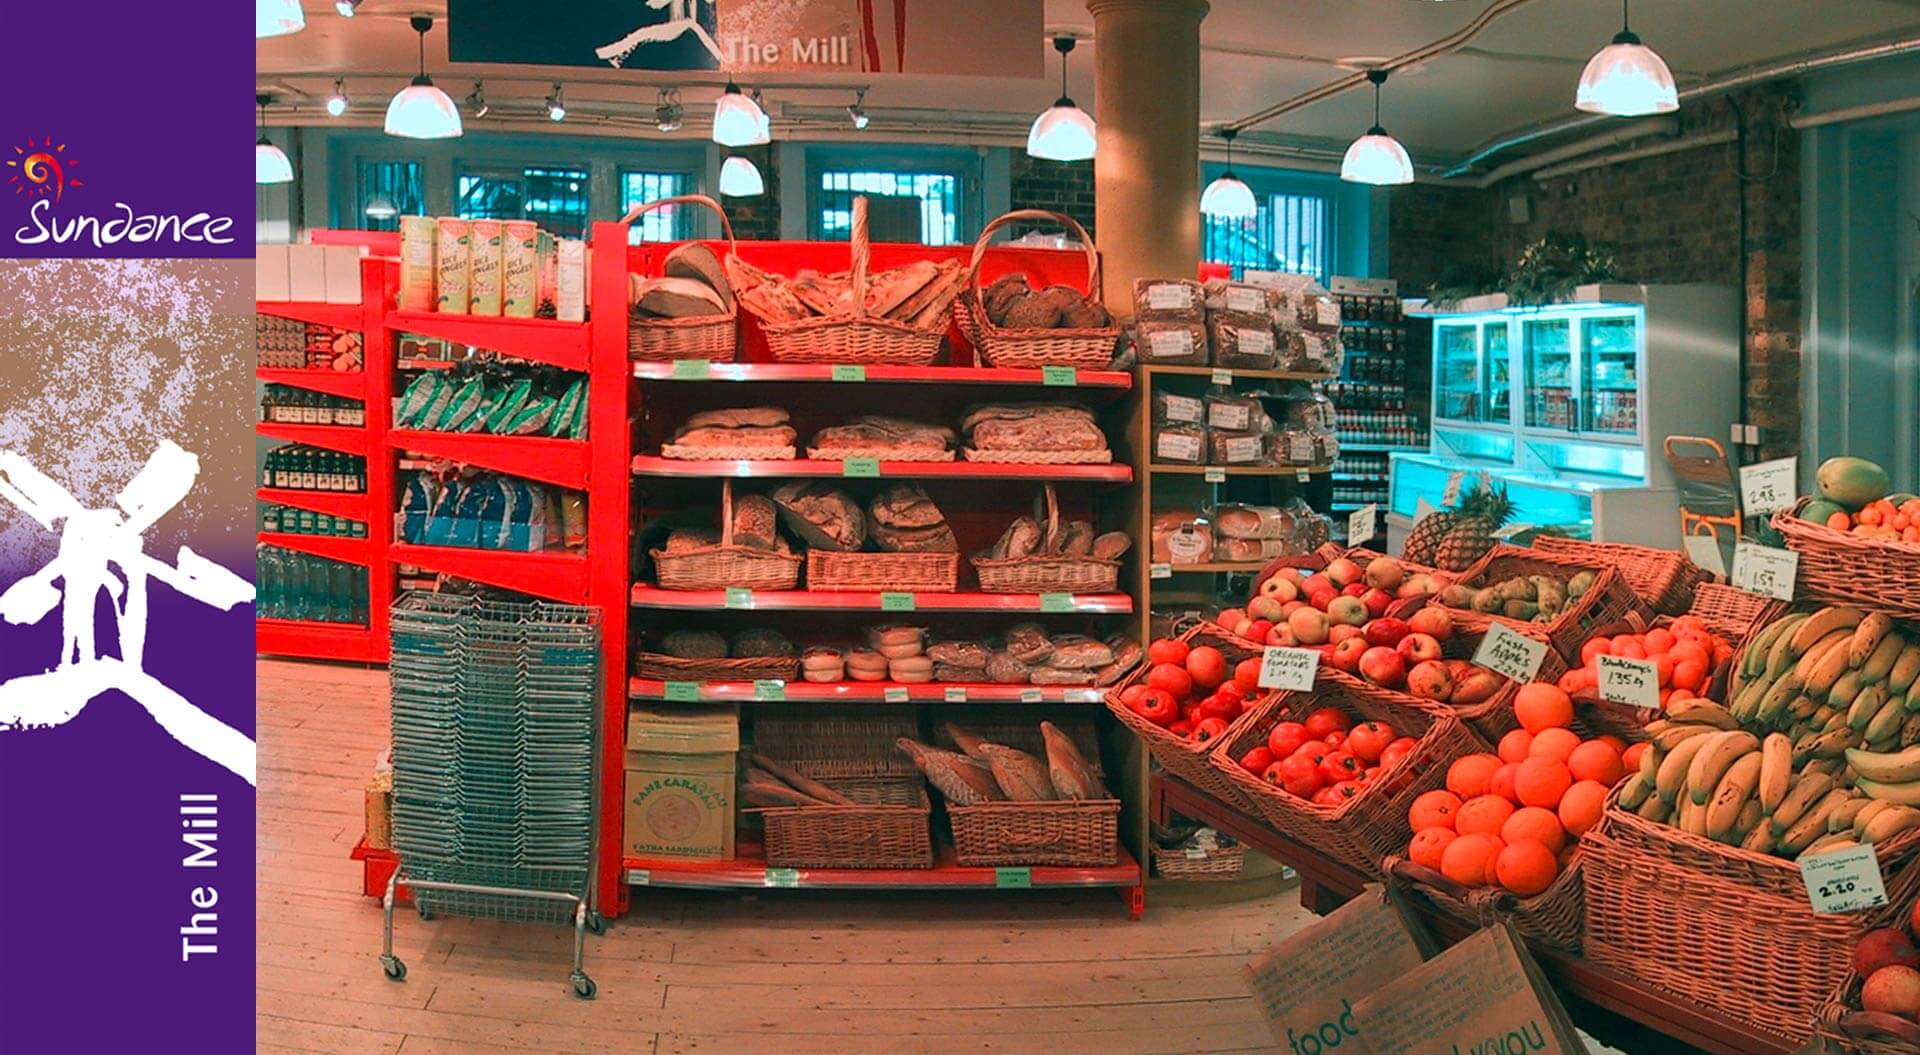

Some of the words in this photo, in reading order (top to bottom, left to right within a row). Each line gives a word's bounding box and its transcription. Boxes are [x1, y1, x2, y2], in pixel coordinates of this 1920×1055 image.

[727, 36, 779, 64] The
[792, 36, 848, 64] Mill
[1819, 882, 1855, 897] 2.20
